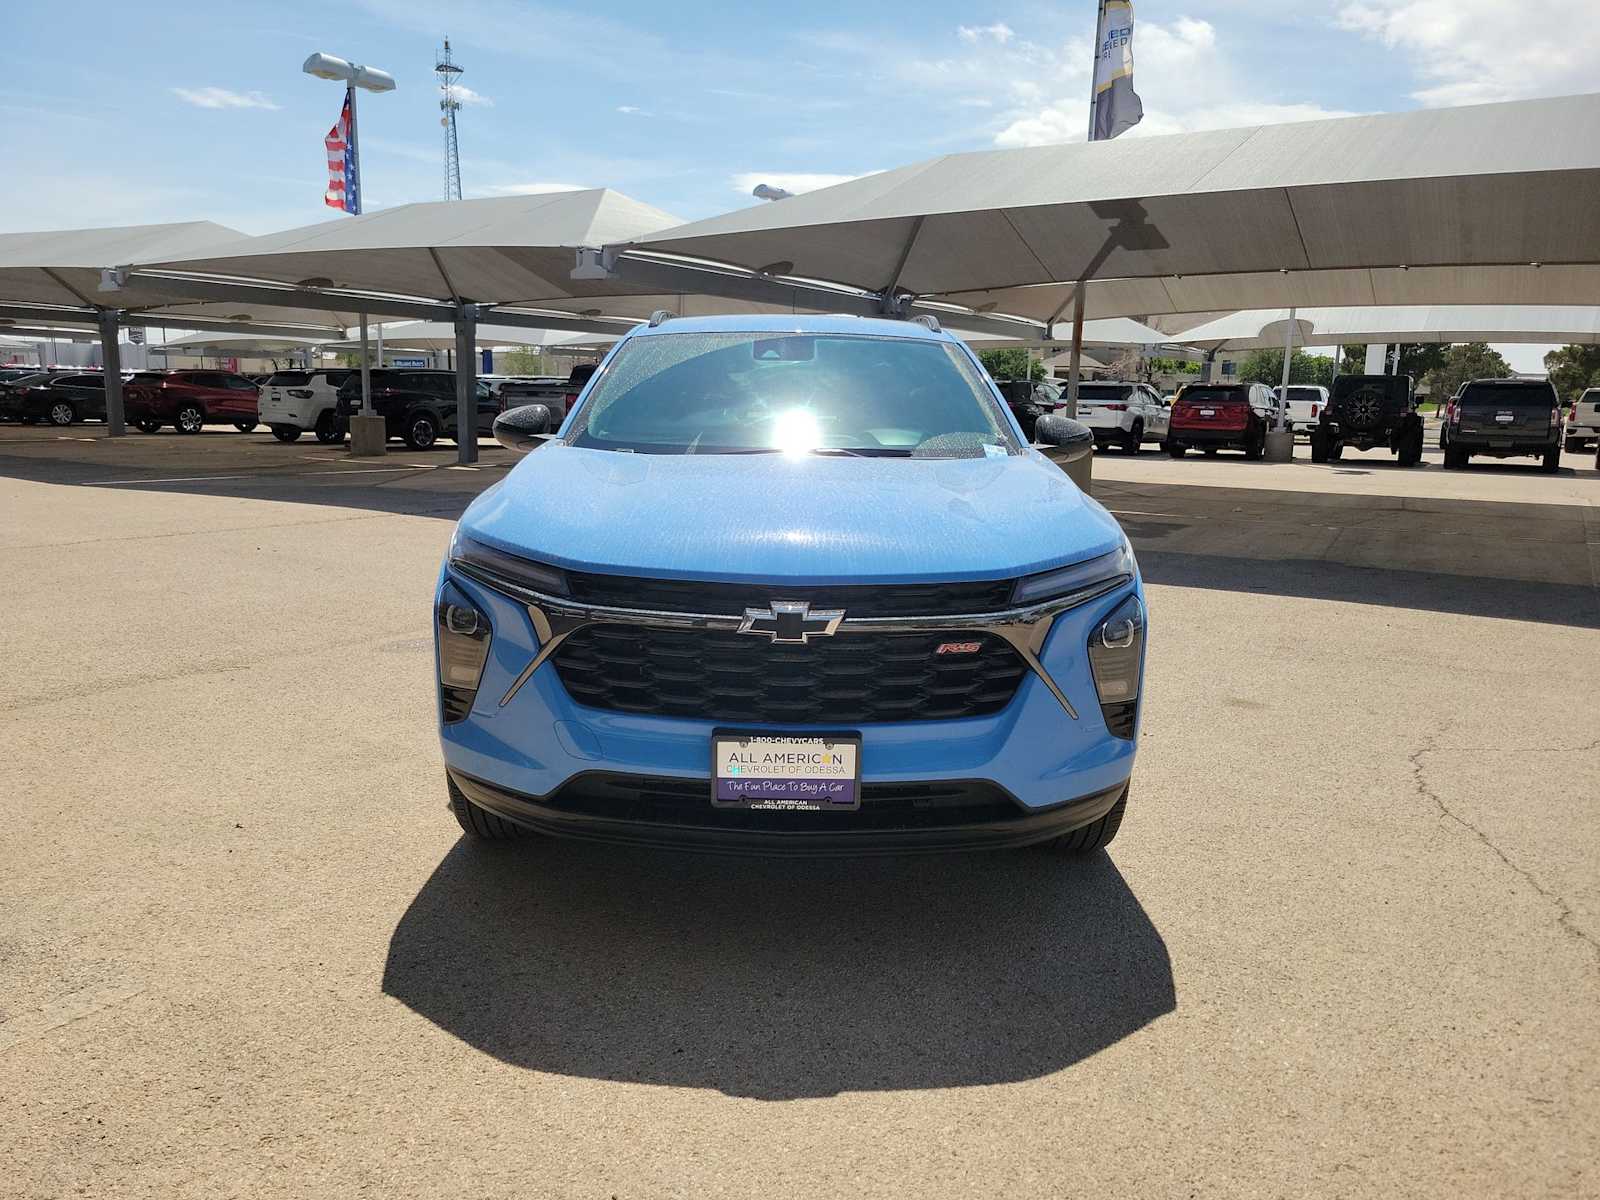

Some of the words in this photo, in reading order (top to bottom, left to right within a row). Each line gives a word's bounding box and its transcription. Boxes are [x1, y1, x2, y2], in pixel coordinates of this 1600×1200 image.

[936, 642, 982, 653] RS
[750, 736, 824, 745] 1-800-CHEVYCARS
[729, 752, 758, 764] ALL
[763, 752, 842, 765] AMERICN
[726, 764, 786, 774] CHEVROLET
[788, 765, 802, 774] OF
[804, 765, 846, 775] ODESSA
[727, 780, 743, 790] The
[762, 780, 786, 791] Place
[787, 781, 799, 791] To
[800, 782, 818, 794] Buy
[818, 782, 827, 791] A
[828, 782, 845, 792] Car
